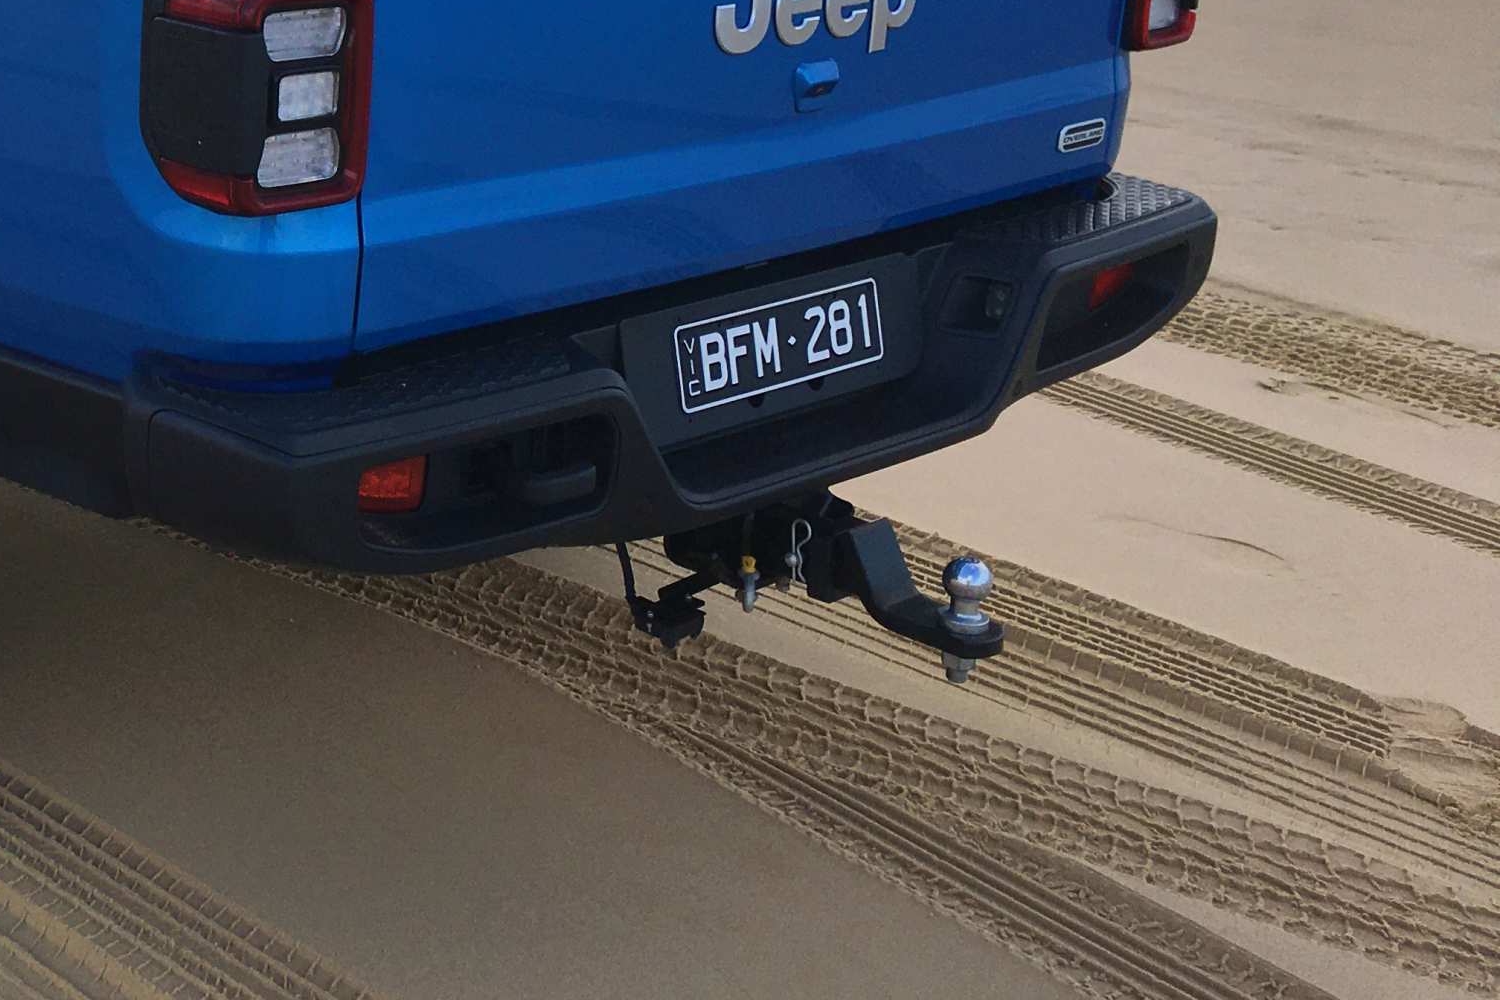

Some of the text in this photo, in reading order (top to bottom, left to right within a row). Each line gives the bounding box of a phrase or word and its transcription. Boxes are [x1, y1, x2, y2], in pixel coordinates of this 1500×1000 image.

[683, 337, 700, 396] VIC
[699, 293, 872, 393] BFM 281
